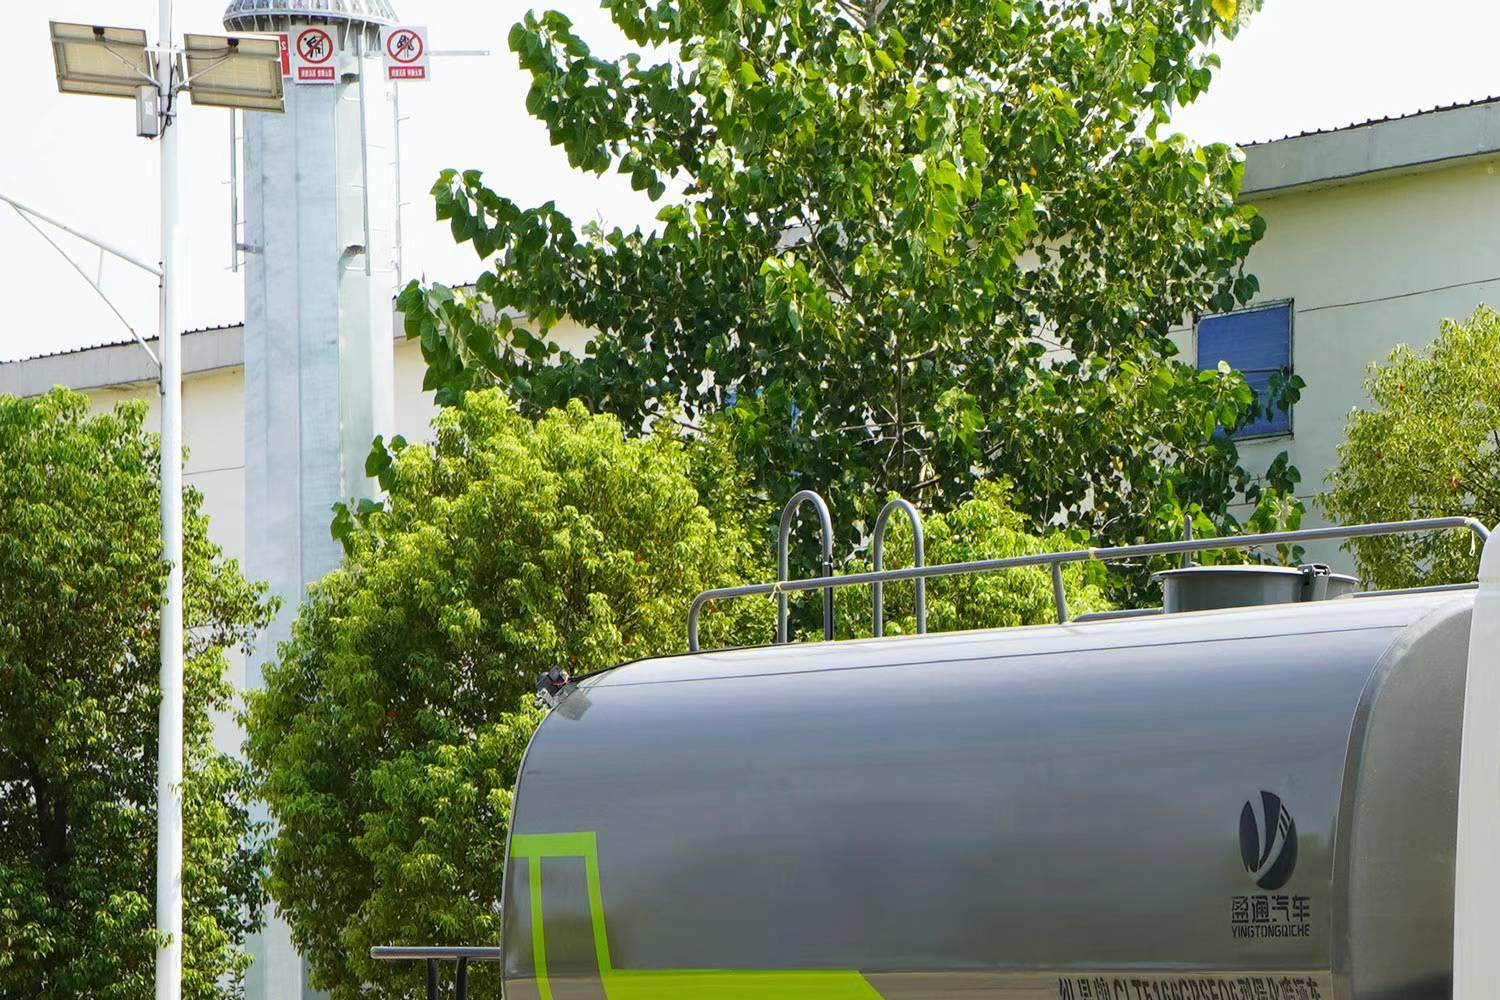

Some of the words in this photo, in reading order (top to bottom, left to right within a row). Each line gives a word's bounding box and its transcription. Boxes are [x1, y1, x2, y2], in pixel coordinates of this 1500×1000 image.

[1231, 895, 1311, 923] 盈通汽车
[1231, 924, 1311, 939] YINGTONGQICHE
